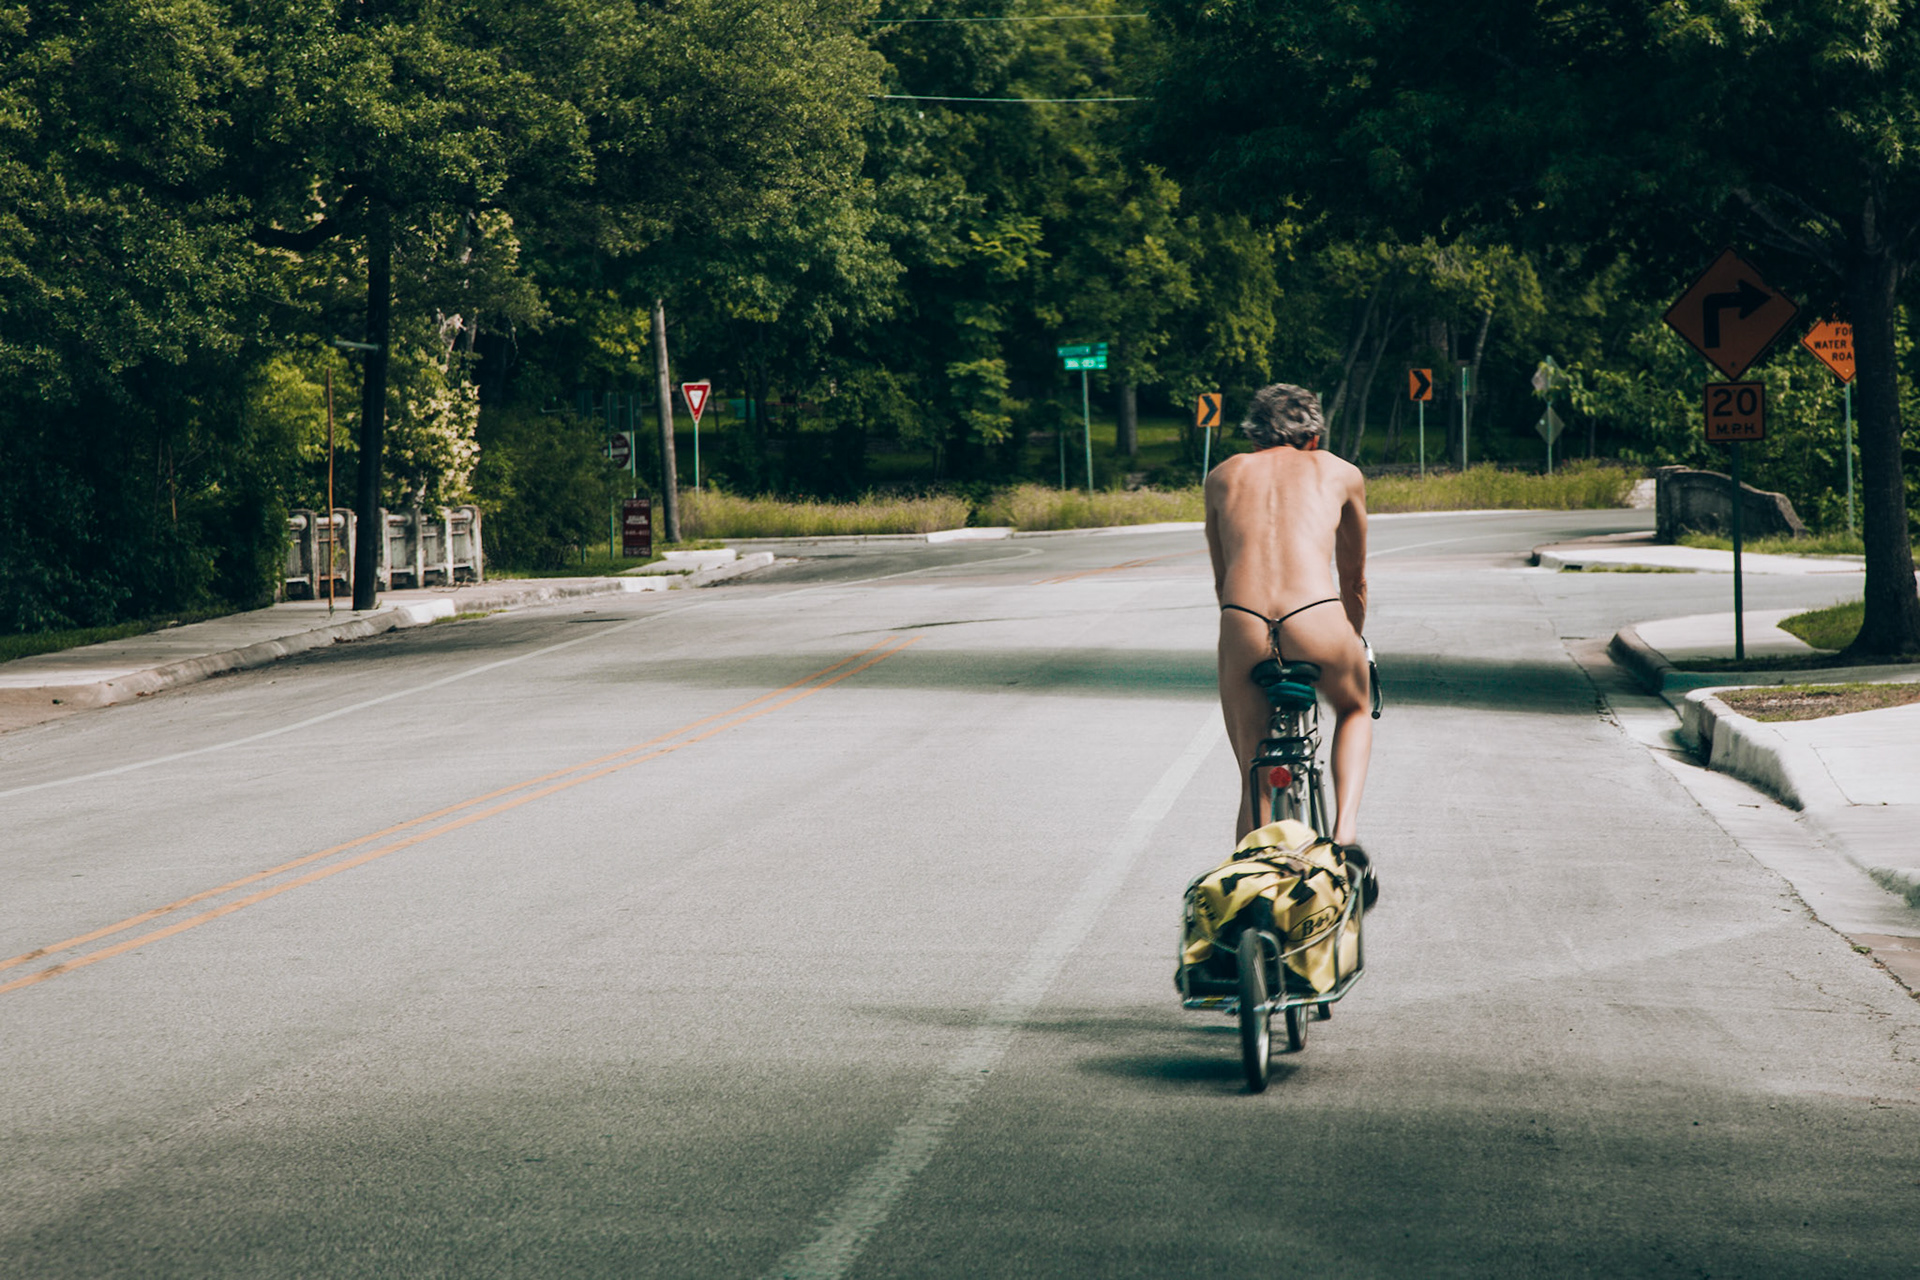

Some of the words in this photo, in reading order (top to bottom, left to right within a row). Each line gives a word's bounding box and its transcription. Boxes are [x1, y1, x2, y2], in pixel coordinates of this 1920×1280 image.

[1813, 340, 1847, 349] WATER
[1832, 352, 1853, 361] ROA
[1712, 387, 1757, 417] 20
